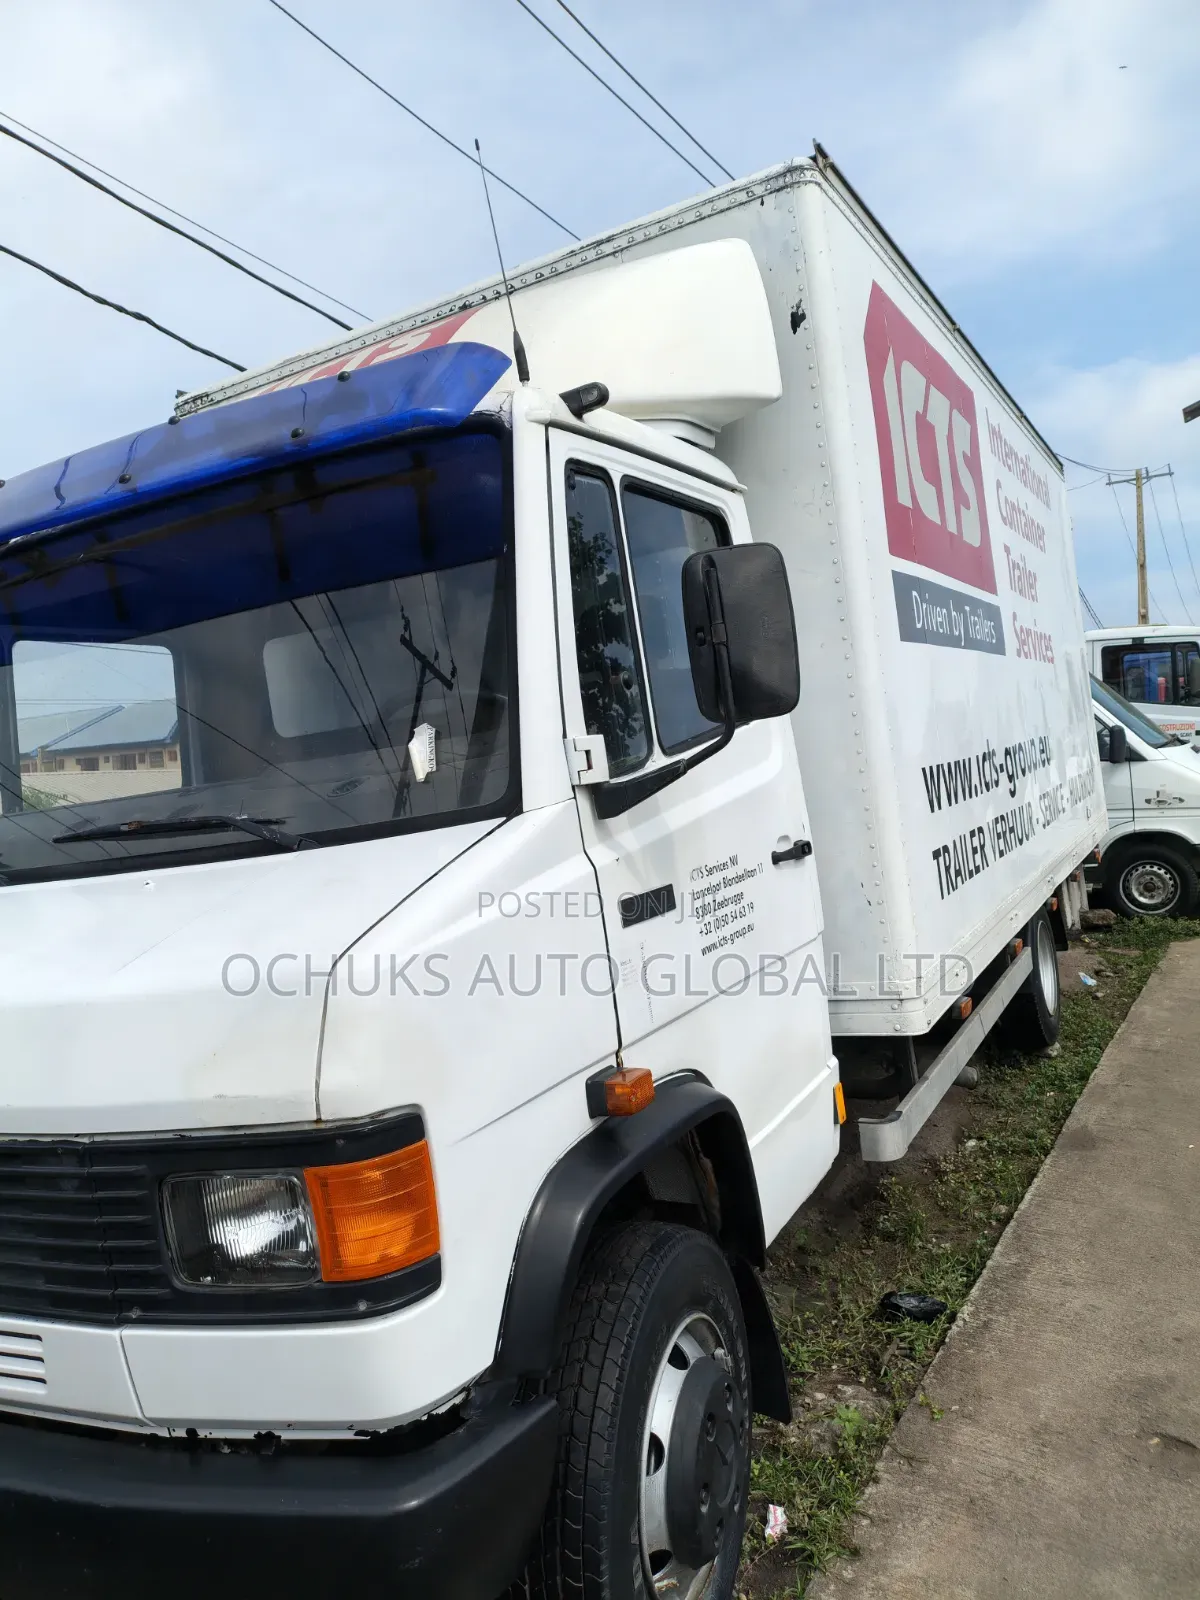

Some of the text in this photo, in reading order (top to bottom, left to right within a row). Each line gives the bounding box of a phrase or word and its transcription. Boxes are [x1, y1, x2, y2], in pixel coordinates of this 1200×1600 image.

[883, 346, 981, 548] ICTS
[985, 407, 1051, 511] International
[996, 478, 1046, 554] Container
[1004, 543, 1038, 603] Trailer
[911, 590, 996, 646] Driven by Trailers
[1012, 611, 1054, 664] Services
[690, 854, 739, 883] ICTS Services NV
[932, 826, 989, 900] TRAILER
[986, 802, 1035, 861] VERHUUR
[695, 891, 744, 920] 8380 Zeebrugge
[713, 912, 729, 934] (0)50
[730, 908, 738, 923] 54
[739, 905, 747, 919] 63
[747, 901, 755, 914] 19
[701, 923, 755, 957] www.icts-group.eu
